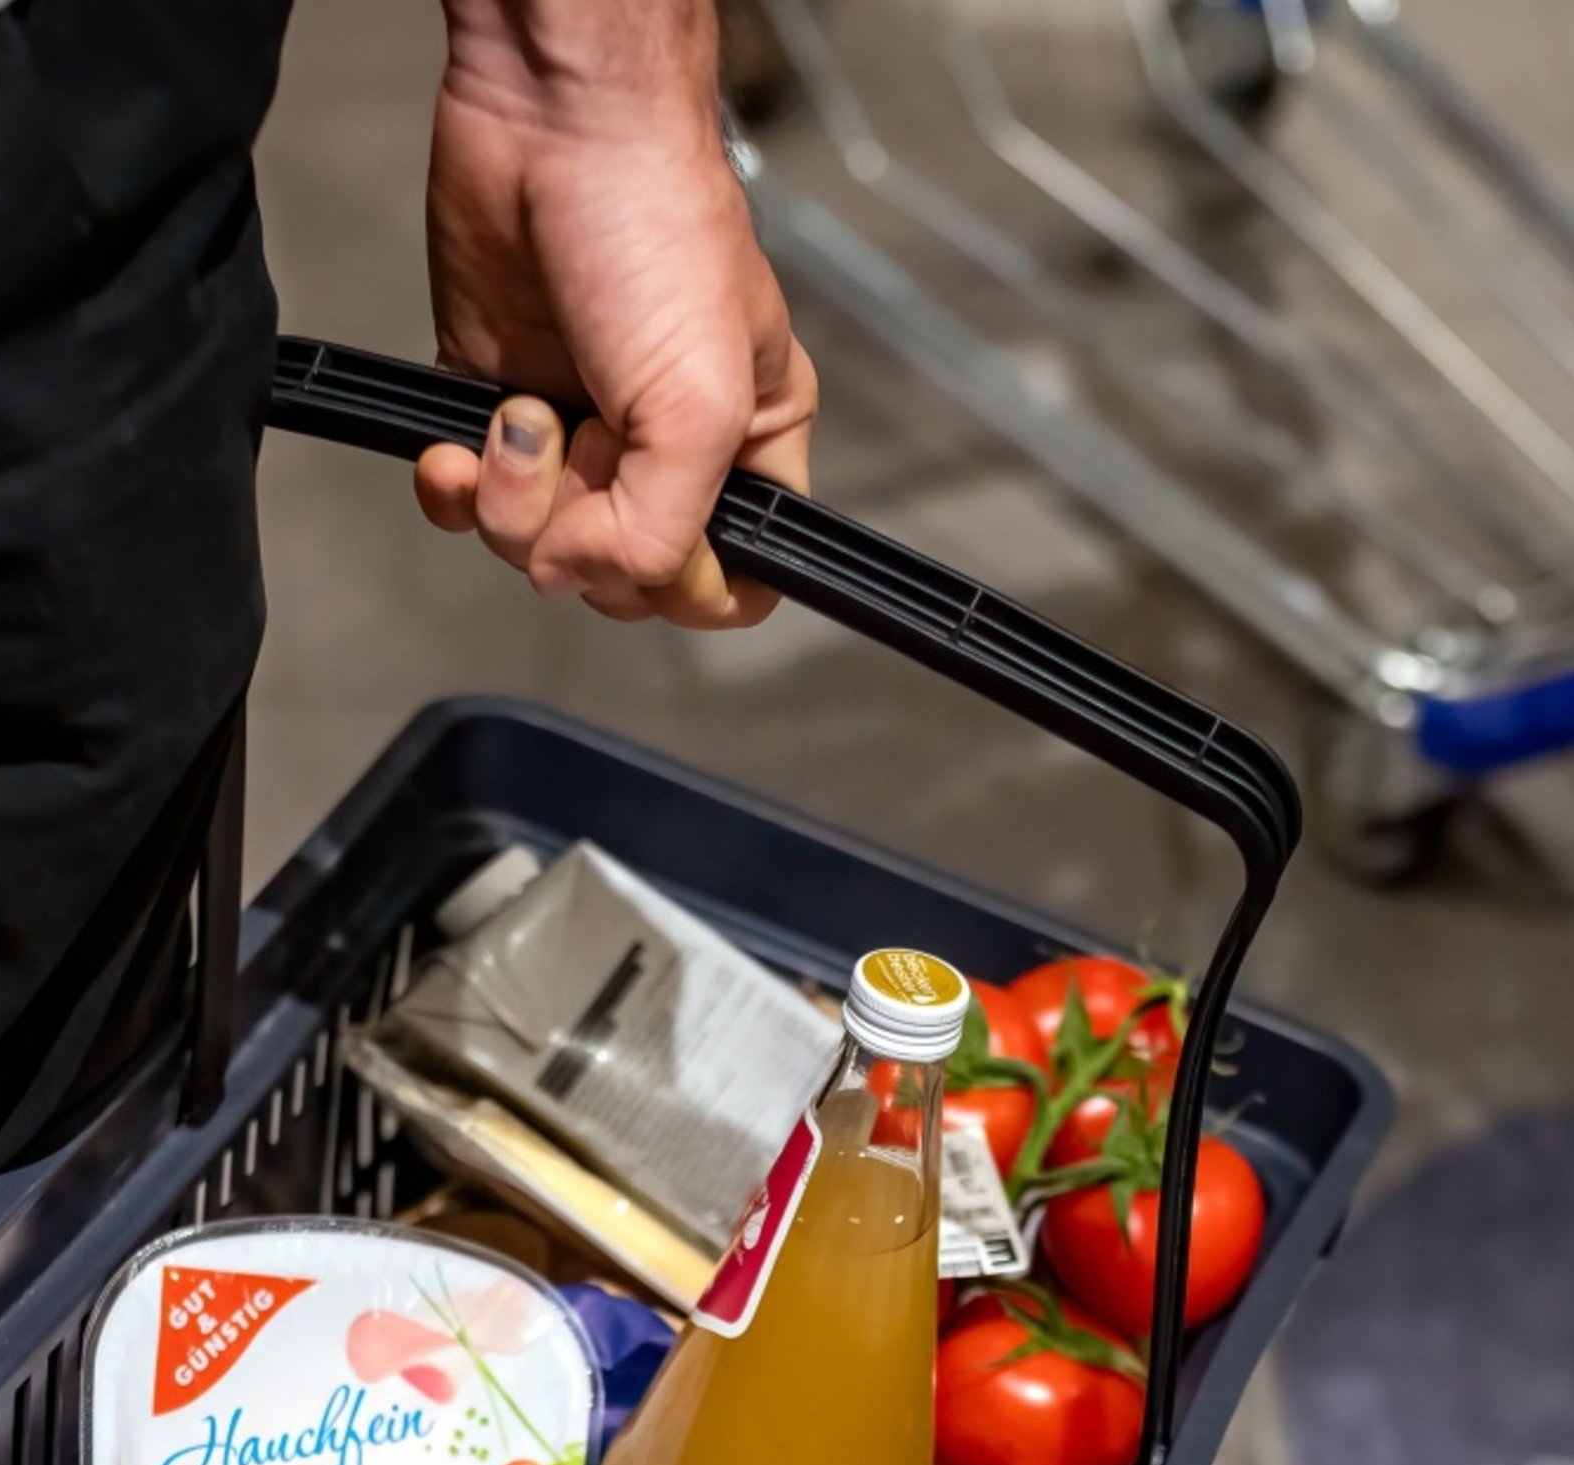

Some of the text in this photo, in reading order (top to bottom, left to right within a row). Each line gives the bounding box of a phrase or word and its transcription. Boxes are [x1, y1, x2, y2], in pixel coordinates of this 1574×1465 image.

[169, 1278, 216, 1330] GUT
[196, 1311, 219, 1335] &
[174, 1288, 274, 1387] GÜNSTIG
